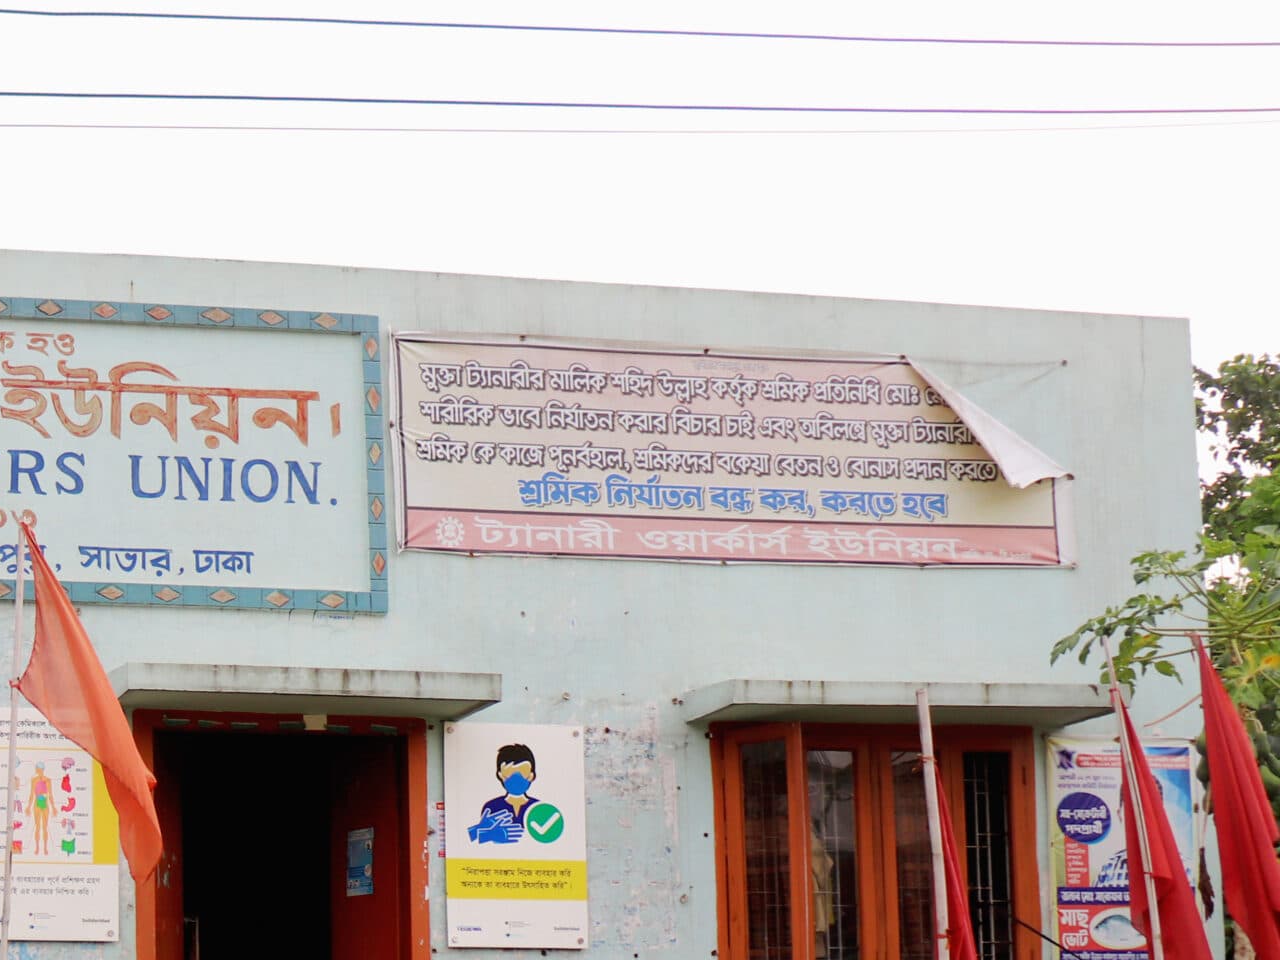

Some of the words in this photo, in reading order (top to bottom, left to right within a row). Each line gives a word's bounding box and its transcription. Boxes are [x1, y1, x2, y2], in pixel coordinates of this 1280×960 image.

[25, 332, 76, 357] হও
[420, 362, 462, 392] মুক্তা
[466, 360, 545, 391] ট্যানারীর
[548, 363, 608, 393] মালিক
[610, 365, 654, 397] শহিদ
[656, 370, 709, 406] উল্লাহ
[711, 373, 759, 406] কর্তৃক
[761, 373, 811, 403] শ্রমিক
[813, 373, 881, 406] প্রতিনিধি
[884, 381, 919, 406] মোঃ
[420, 396, 494, 426] শারীরিক
[498, 404, 541, 429] ভাবে
[545, 400, 615, 432] নির্যাতন
[617, 409, 668, 434] করার
[671, 406, 722, 436] বিচার
[725, 410, 754, 439] চাই
[758, 417, 796, 442] এবং
[798, 411, 868, 443] অবিলম্বে
[871, 420, 909, 449] মুক্তা
[128, 453, 339, 507] UNION.
[416, 434, 468, 462] শ্রমিক
[471, 441, 496, 464] কে
[499, 443, 545, 466] কাজে
[634, 442, 713, 473] শ্রমিকদের
[716, 451, 771, 477] বকেয়া
[774, 454, 824, 477] বেতন
[825, 457, 840, 477] ও
[843, 457, 900, 480] বোনাস
[903, 459, 947, 480] প্রদান
[949, 460, 998, 482] করতে
[517, 471, 601, 507] শ্রমিক
[605, 473, 705, 510] নির্যাতন
[708, 487, 753, 514] বন্ধ
[820, 490, 896, 520] করতে
[901, 492, 949, 522] হবে
[472, 515, 622, 550] ট্যানারী
[636, 525, 794, 556] ওয়ার্কার্স
[802, 527, 962, 561] ইউনিয়ন
[193, 550, 255, 574] ঢাকা
